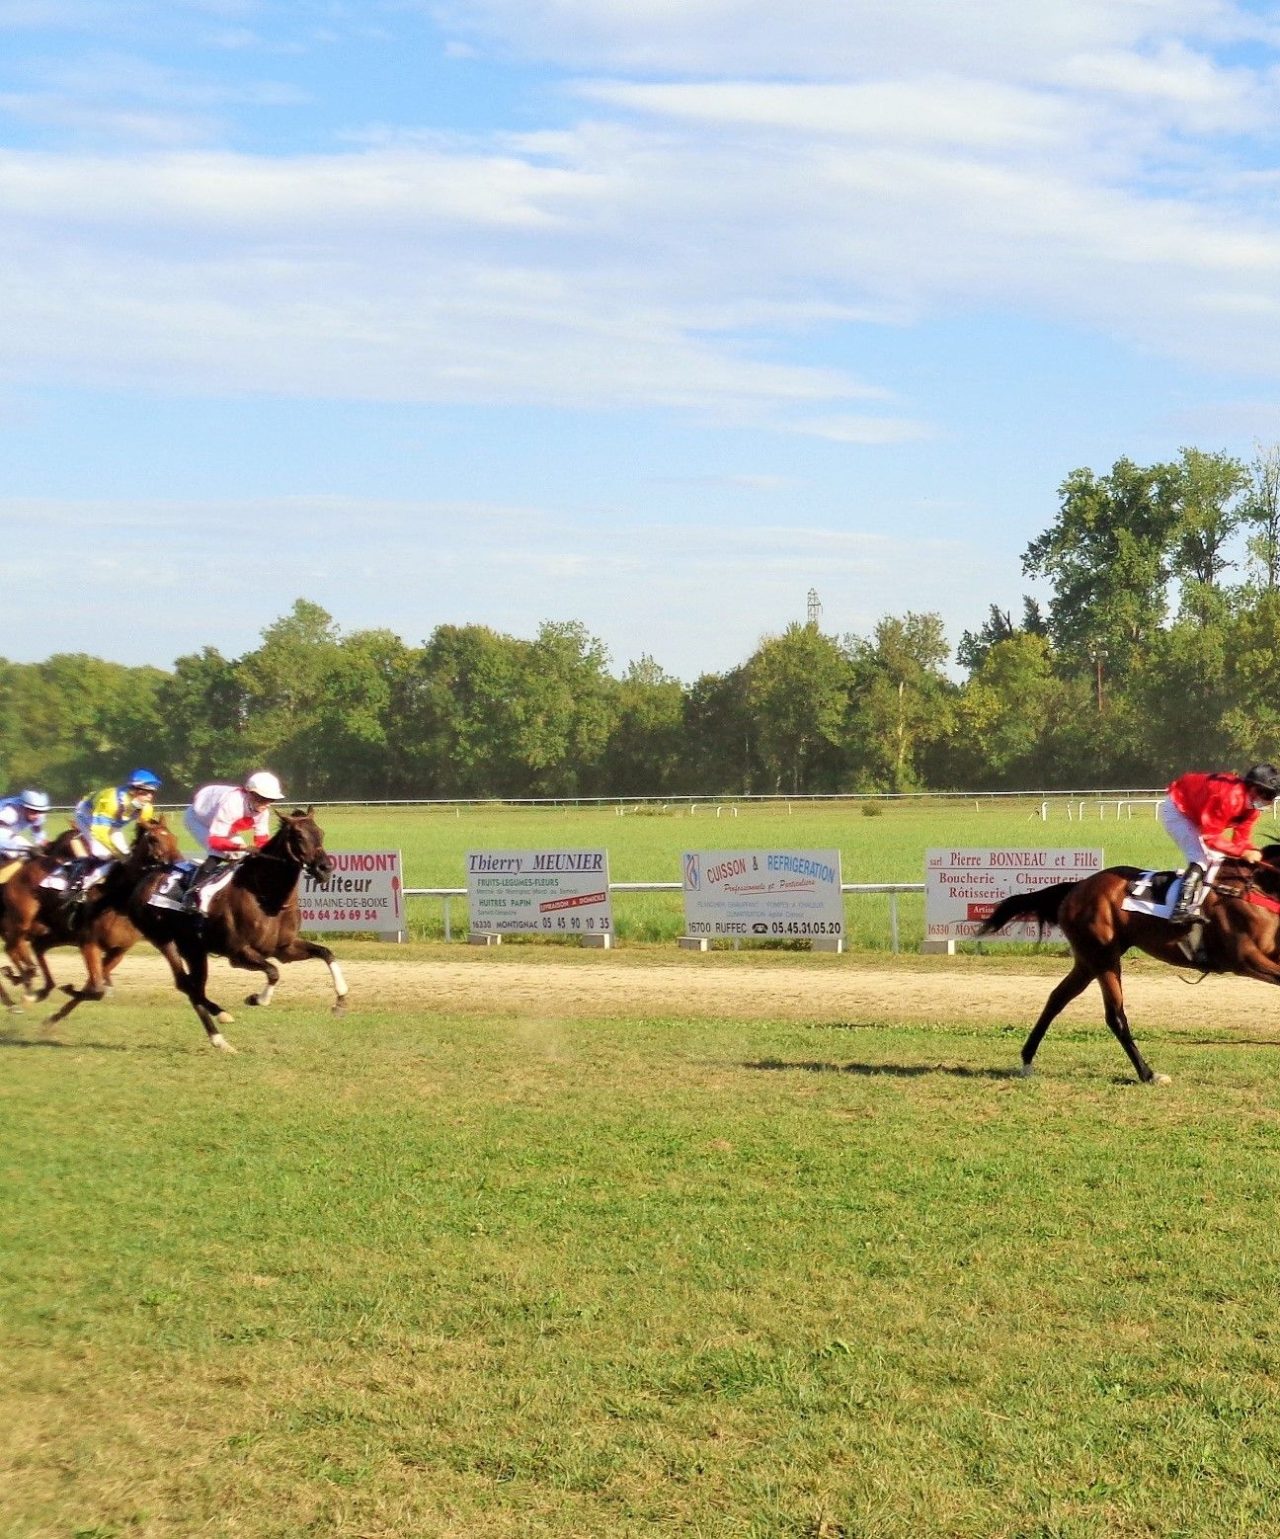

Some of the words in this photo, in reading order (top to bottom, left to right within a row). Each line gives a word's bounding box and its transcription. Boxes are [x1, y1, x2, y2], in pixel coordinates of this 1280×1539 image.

[470, 854, 523, 874] Thierry
[533, 854, 603, 870] MEUNIER
[950, 852, 981, 866] Pierre
[989, 852, 1047, 866] BONNEAU
[1055, 855, 1065, 866] et
[1074, 852, 1098, 867] Fille
[707, 858, 747, 884] CUISSON
[752, 856, 759, 871] &
[767, 855, 836, 884] REFRIGERATION
[939, 872, 995, 884] Boucherie
[315, 898, 389, 908] MAINE-DE-BOIXE
[479, 899, 506, 907] HUITRES
[511, 899, 531, 907] PAPIN
[302, 910, 315, 920] 06
[496, 920, 538, 929] MONTIGNAC
[542, 917, 552, 929] 05
[557, 917, 566, 929] 45
[571, 917, 581, 929] 90
[585, 917, 595, 929] 10
[599, 917, 610, 929] 35
[688, 922, 711, 932] 16700
[715, 922, 747, 933] RUFFEC
[772, 921, 841, 934] 05.45.31.05.20
[1026, 926, 1036, 937] 05
